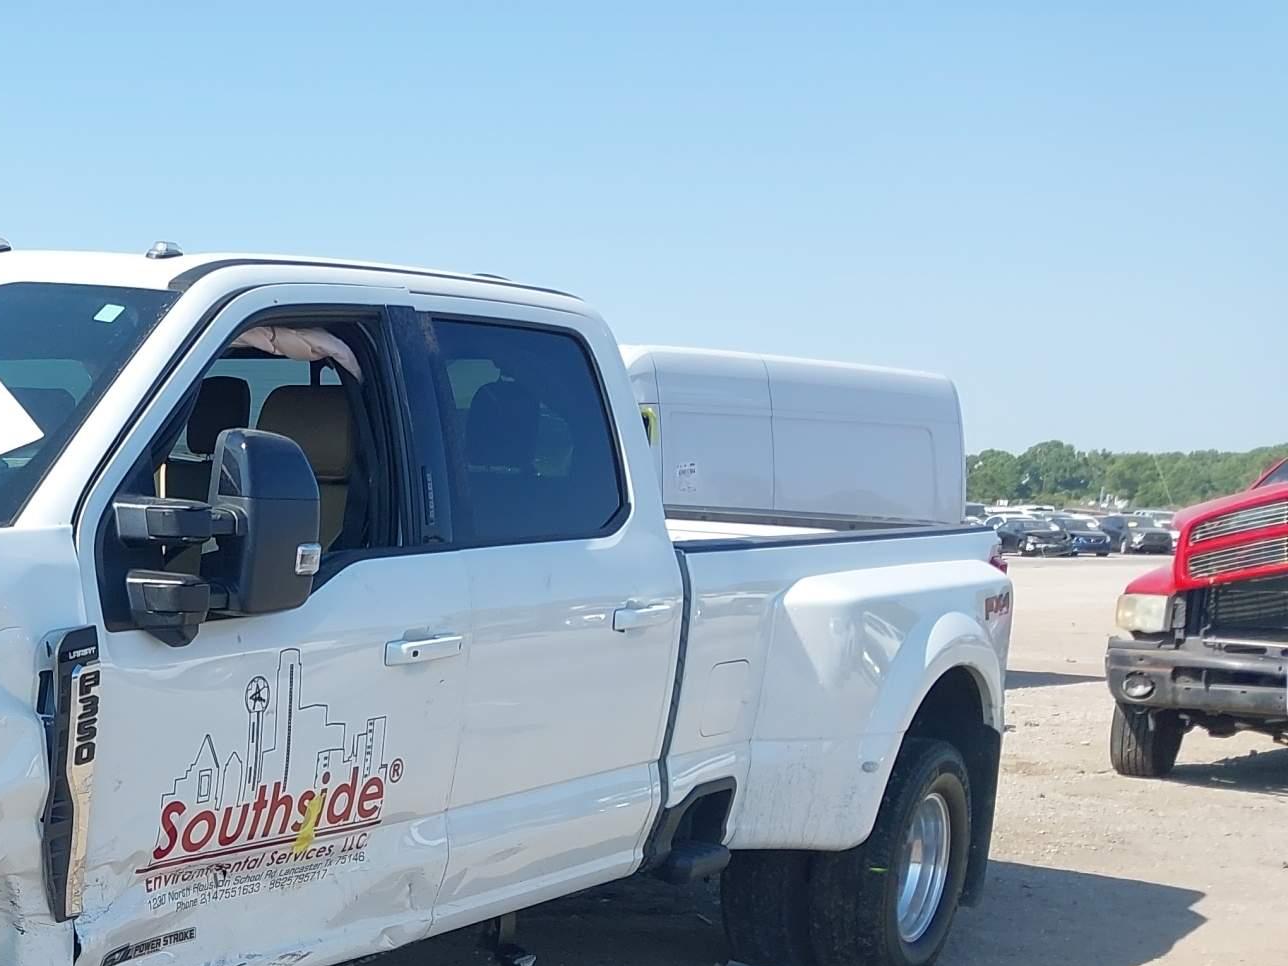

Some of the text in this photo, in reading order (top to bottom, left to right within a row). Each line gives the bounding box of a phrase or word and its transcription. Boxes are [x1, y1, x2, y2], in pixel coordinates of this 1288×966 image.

[152, 766, 384, 860] Southside
[192, 878, 231, 894] Houson
[233, 870, 264, 886] School
[134, 938, 162, 956] POWER
[162, 929, 195, 947] STROKE
